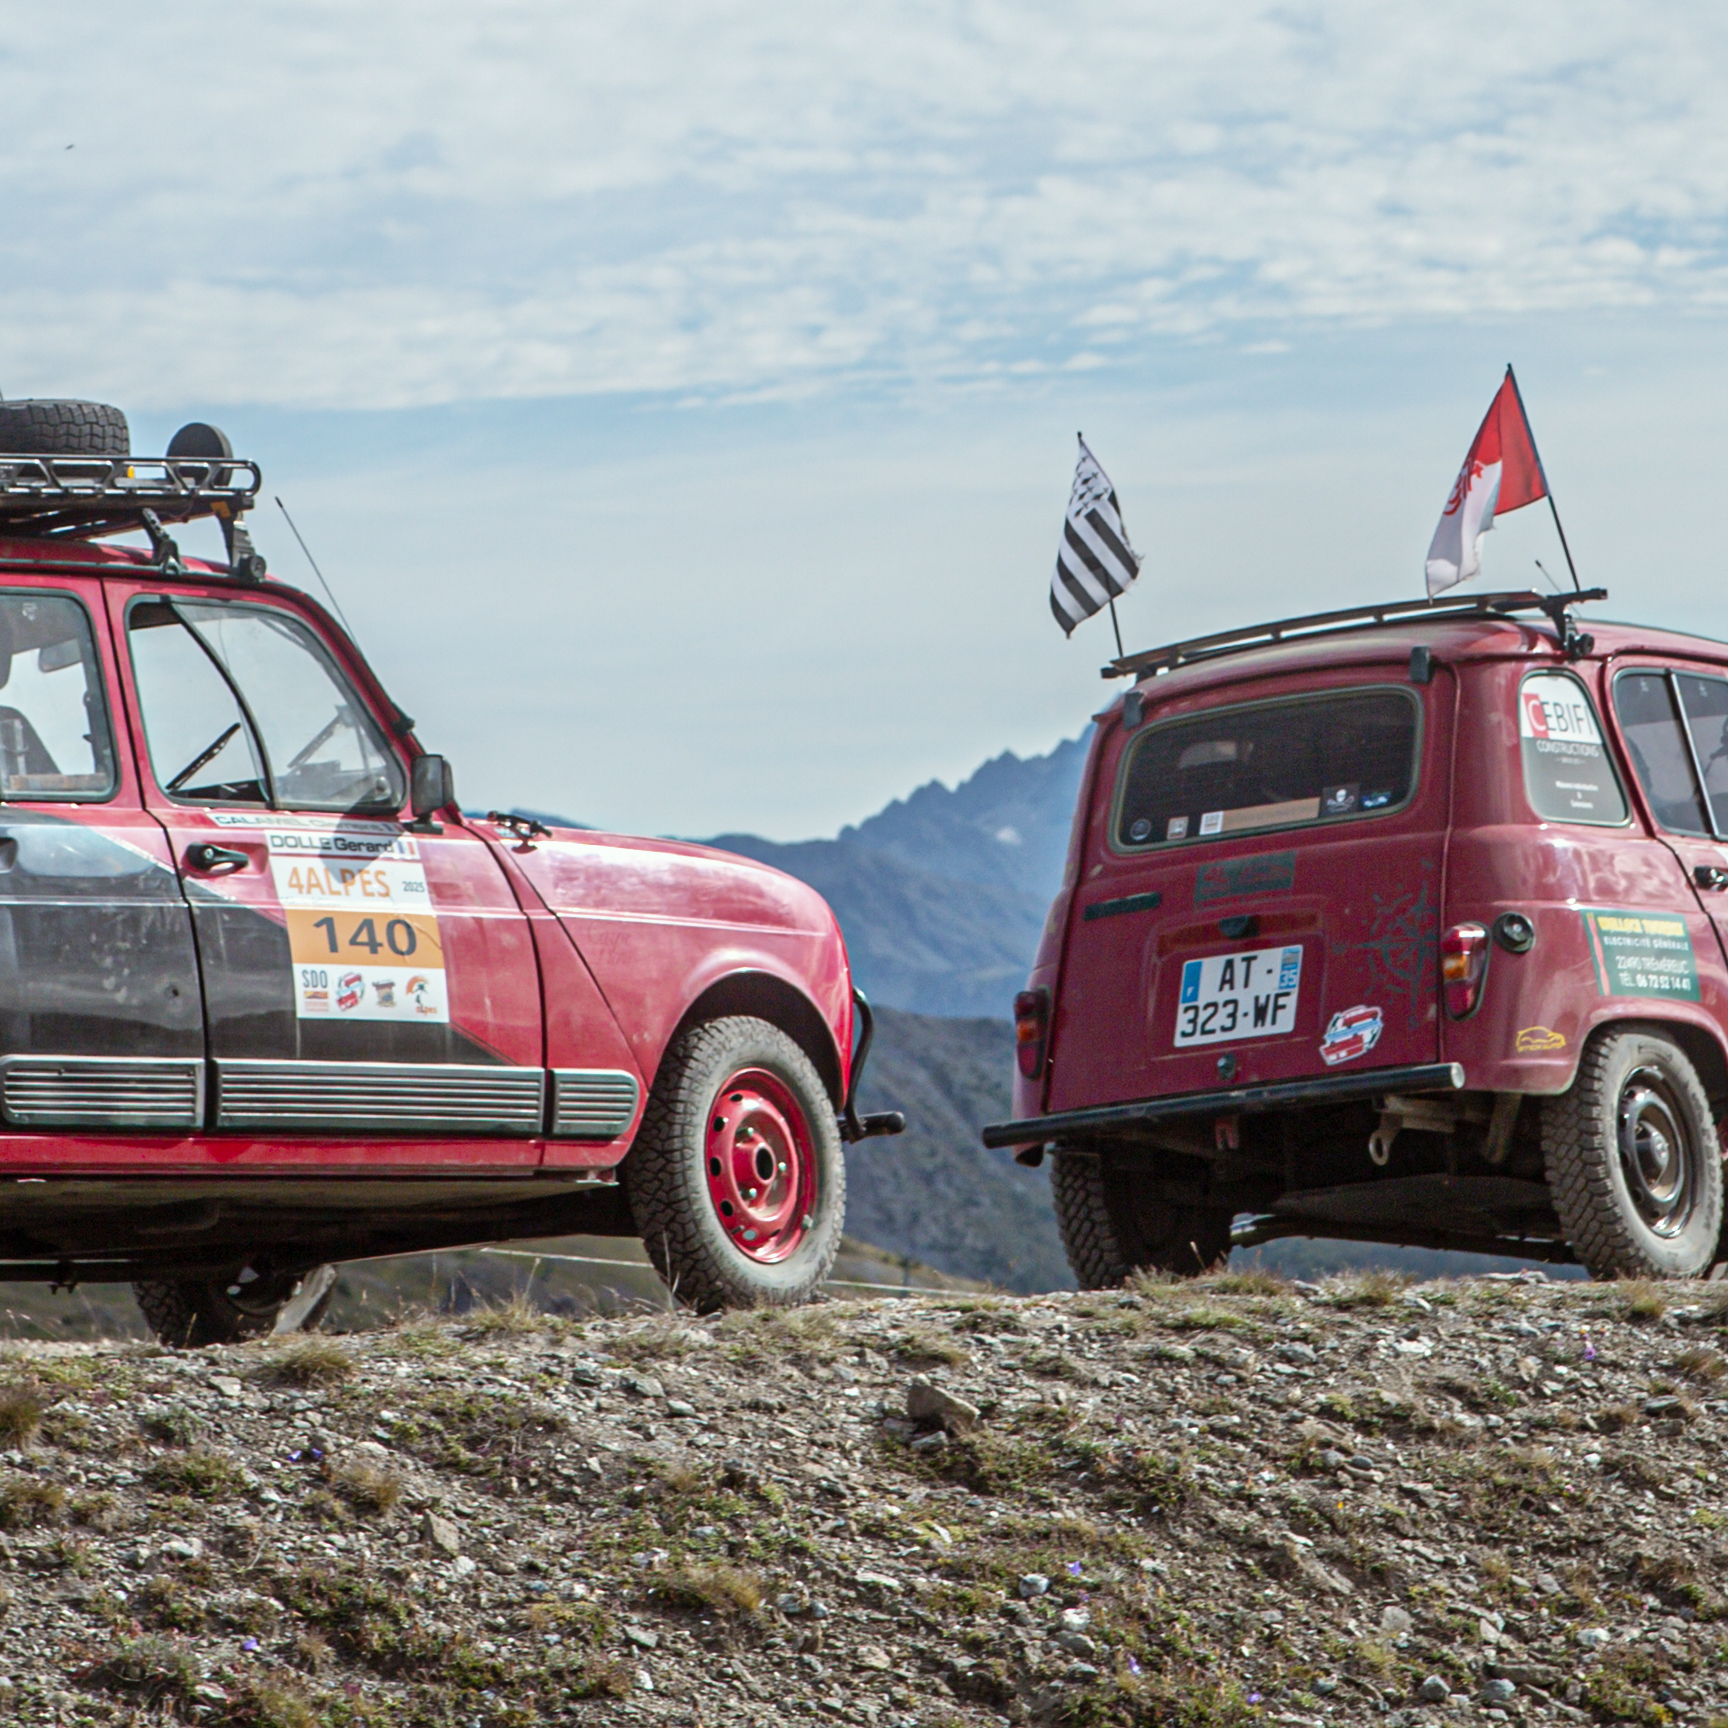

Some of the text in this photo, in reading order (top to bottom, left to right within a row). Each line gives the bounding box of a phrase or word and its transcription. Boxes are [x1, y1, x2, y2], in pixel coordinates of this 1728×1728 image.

[1536, 740, 1599, 757] CONSTRUCTIONS
[271, 834, 394, 853] DOLLE Gerard
[287, 866, 391, 899] 4ALPES
[402, 880, 426, 893] 2025
[313, 916, 417, 957] 140
[301, 969, 328, 989] SDO
